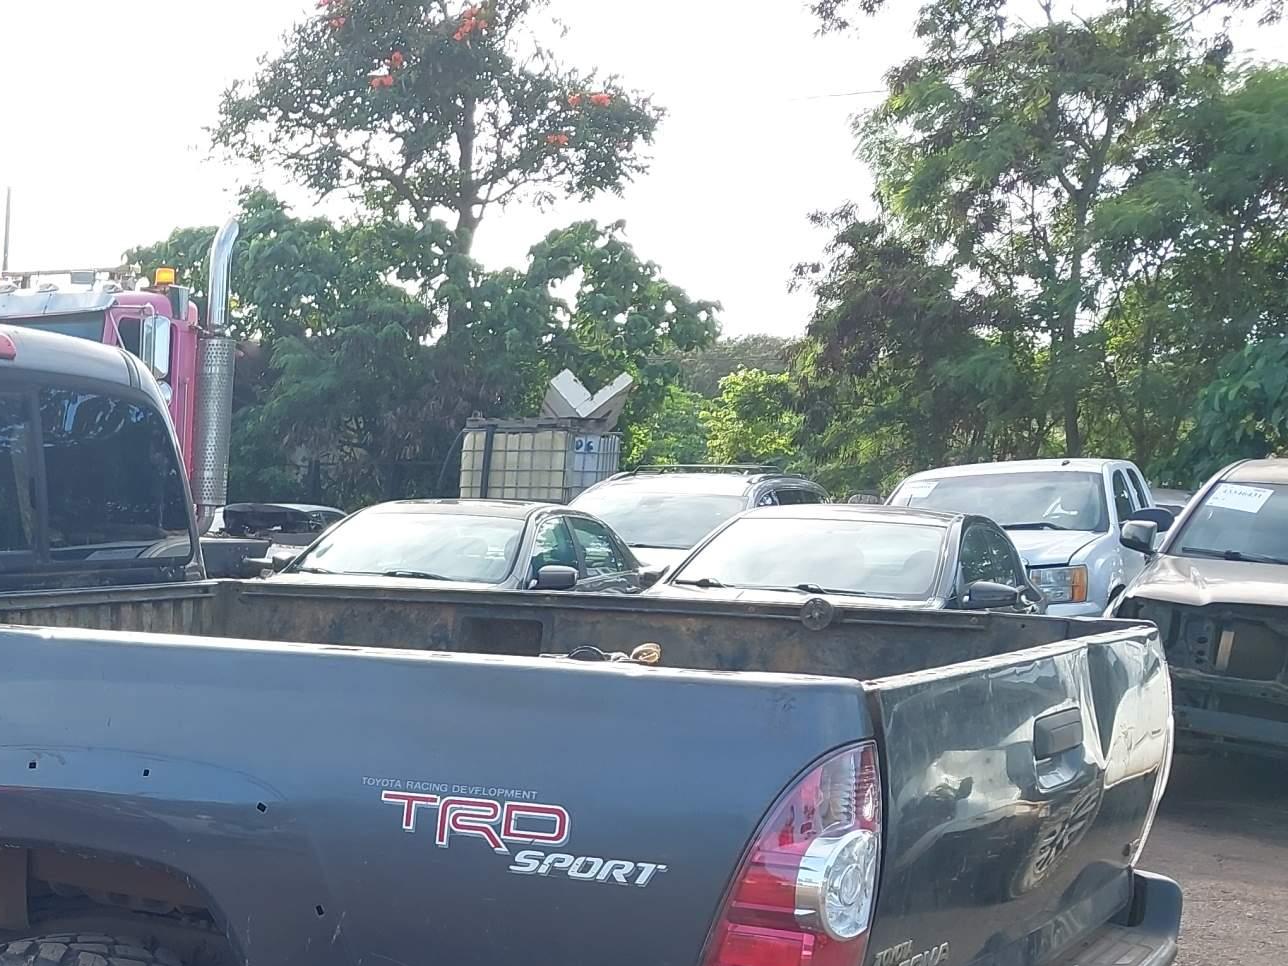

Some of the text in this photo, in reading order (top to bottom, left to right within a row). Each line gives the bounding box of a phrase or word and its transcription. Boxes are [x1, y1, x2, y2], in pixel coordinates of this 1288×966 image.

[362, 776, 538, 800] TOYOTA RACING DEVELOPMENT
[381, 789, 571, 856] TRD
[507, 850, 669, 888] SPORT
